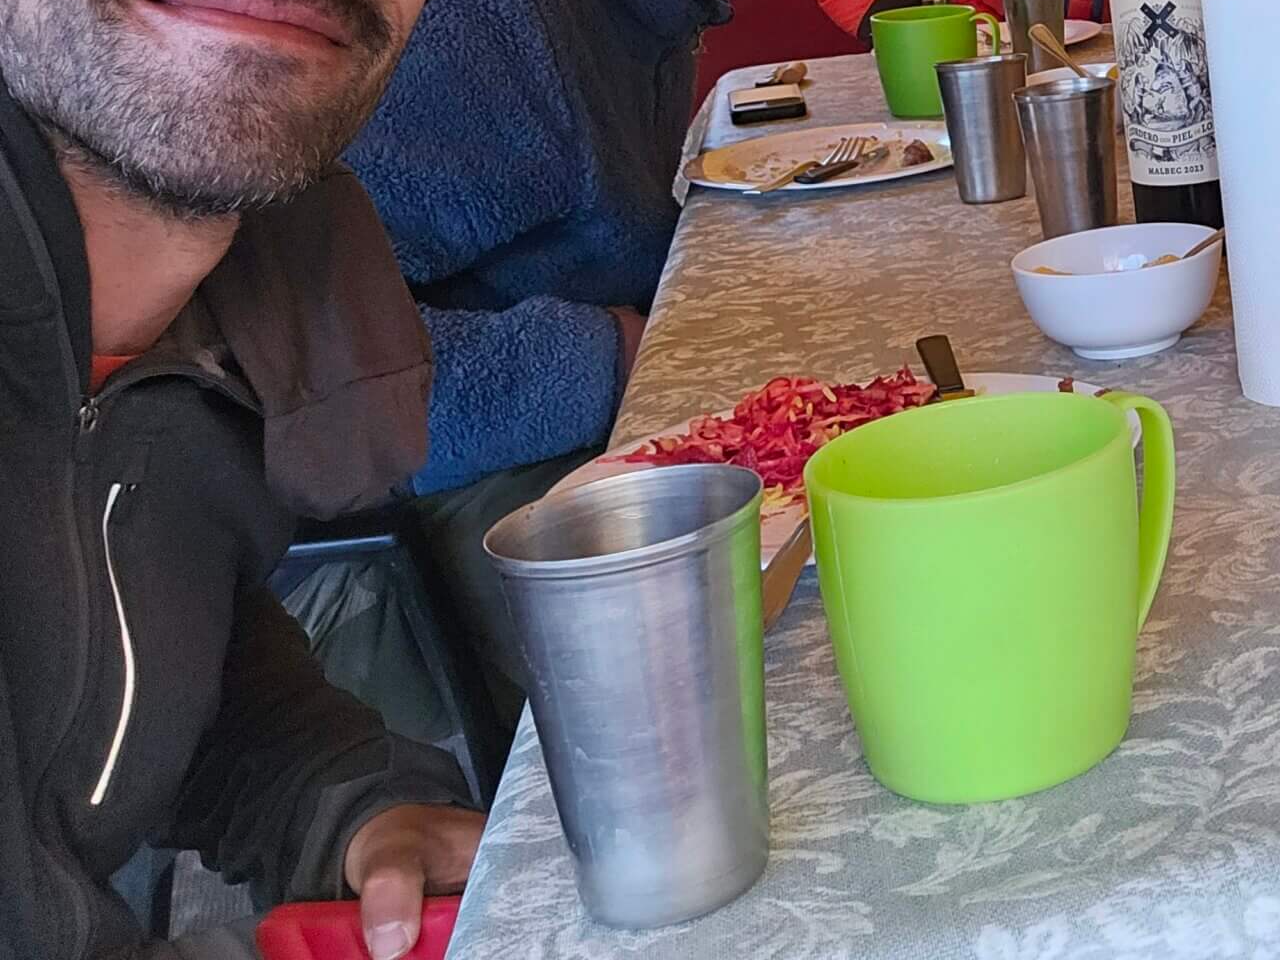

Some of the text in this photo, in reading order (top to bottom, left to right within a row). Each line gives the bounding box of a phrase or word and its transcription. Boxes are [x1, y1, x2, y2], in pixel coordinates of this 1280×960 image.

[1172, 130, 1194, 143] PIEL
[1201, 121, 1213, 133] LO
[1148, 164, 1204, 175] MALBEC 2023
